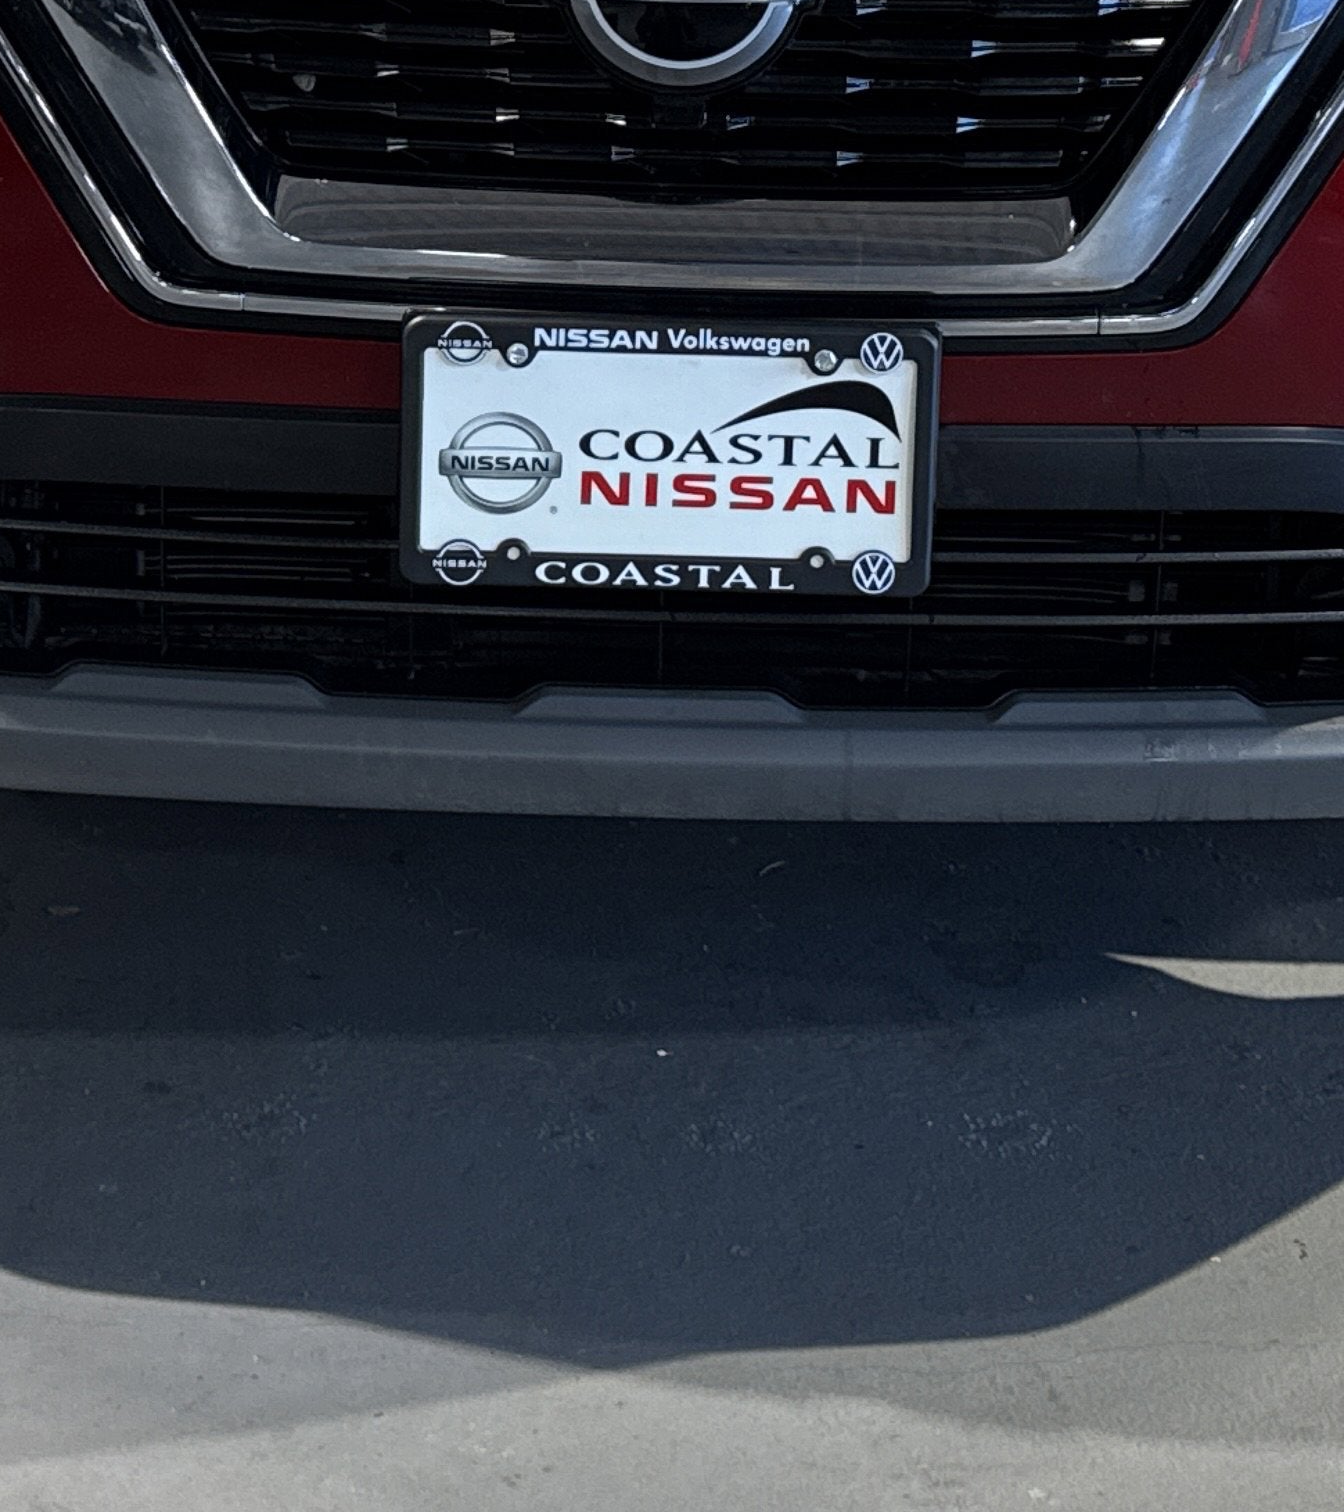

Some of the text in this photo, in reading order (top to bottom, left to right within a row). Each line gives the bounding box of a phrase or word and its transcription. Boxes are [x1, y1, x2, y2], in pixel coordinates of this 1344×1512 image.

[437, 338, 493, 349] NISSAN
[534, 327, 810, 356] NISSAN Volkswagen
[451, 454, 551, 473] NISSAN
[578, 429, 901, 470] COASTAL
[580, 470, 897, 515] NISSAN
[432, 557, 487, 569] NISSAN
[534, 561, 794, 592] COASTAL
